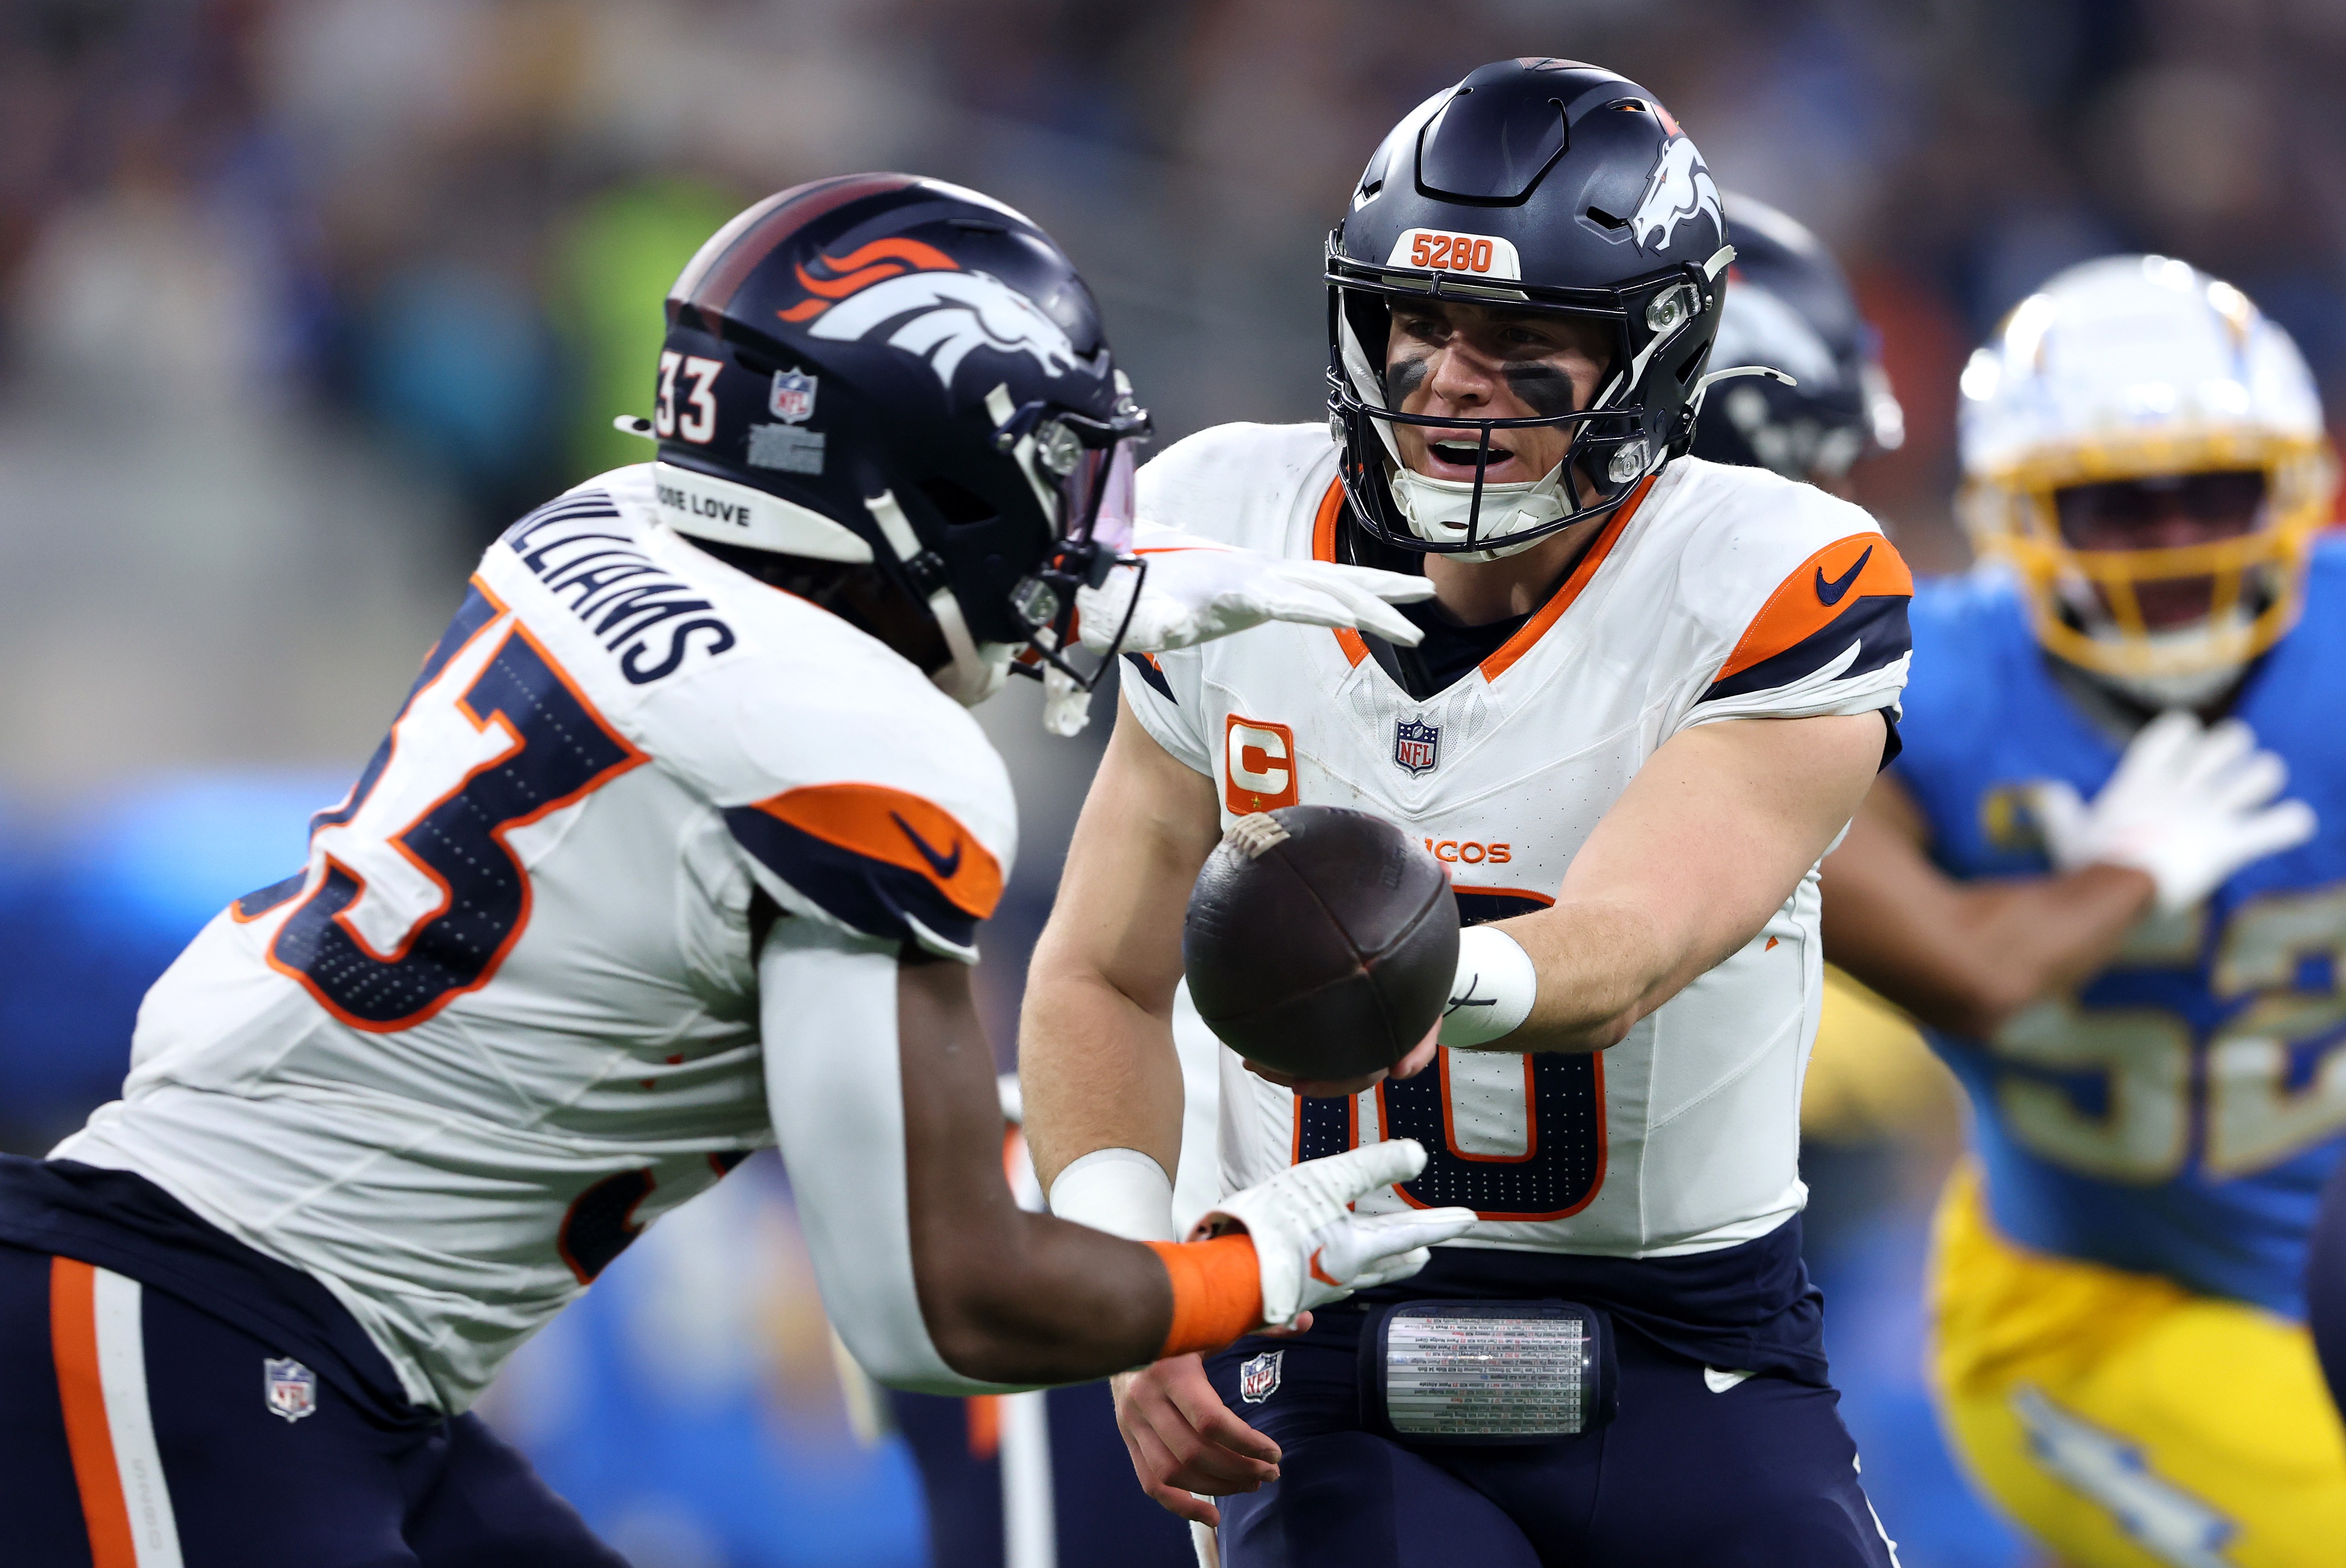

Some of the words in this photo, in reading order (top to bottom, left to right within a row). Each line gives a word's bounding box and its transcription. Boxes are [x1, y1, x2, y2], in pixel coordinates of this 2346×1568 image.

[1411, 234, 1493, 272] 5280
[656, 350, 725, 445] 33
[691, 493, 749, 526] LOVE
[1229, 723, 1289, 795] C
[1399, 741, 1432, 767] NFL
[1990, 880, 2346, 1186] 52
[1247, 1370, 1274, 1395] NFL
